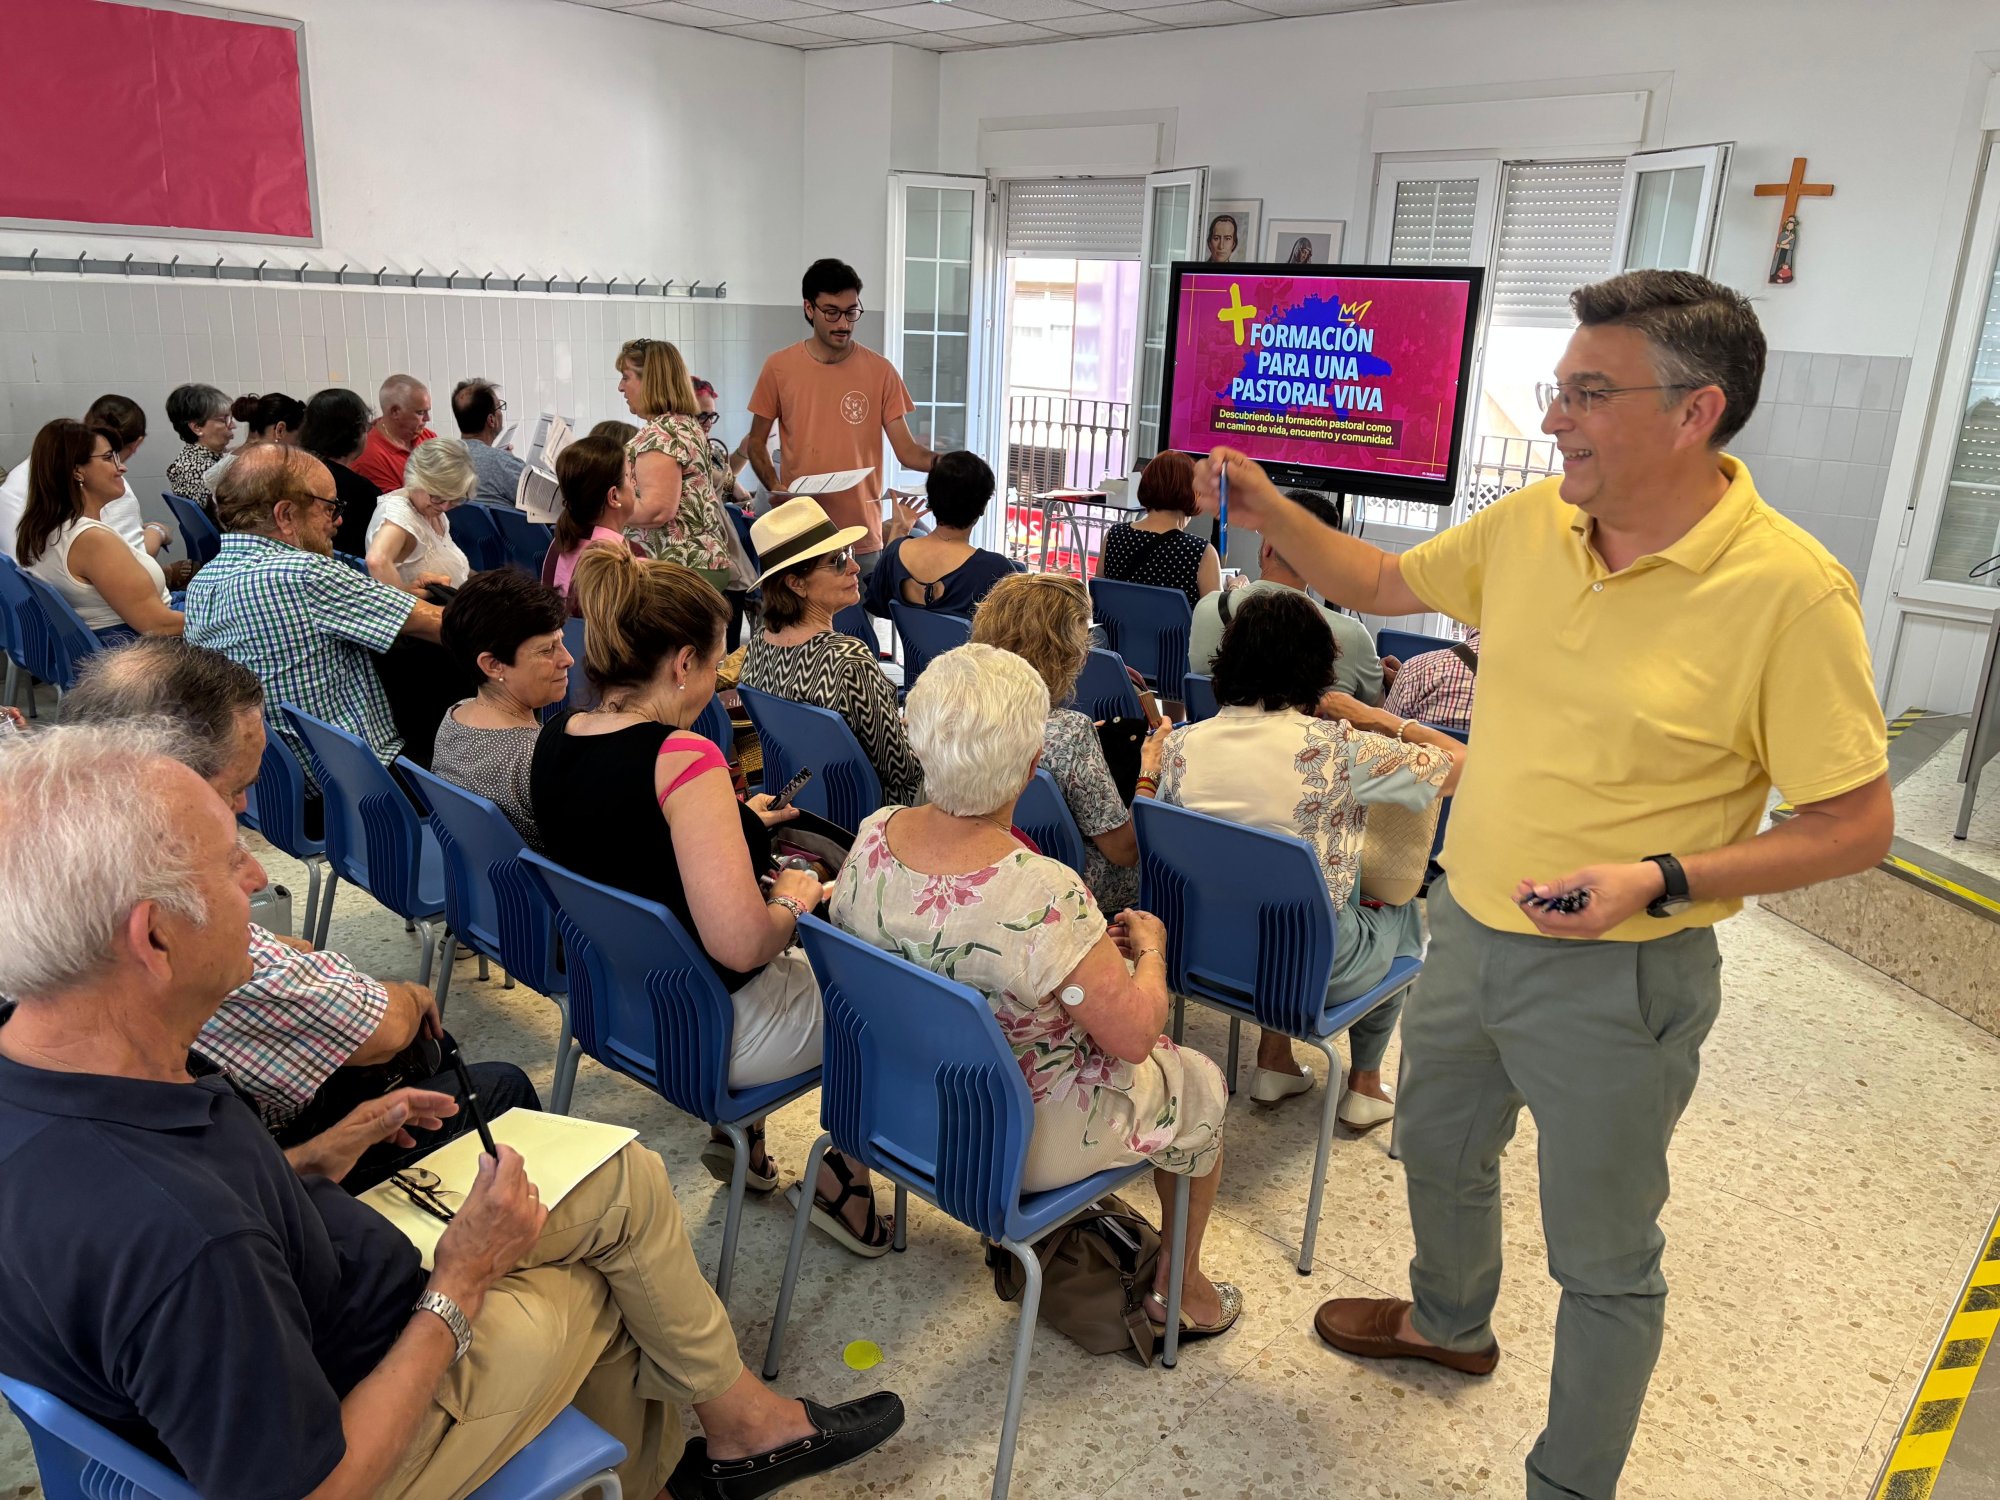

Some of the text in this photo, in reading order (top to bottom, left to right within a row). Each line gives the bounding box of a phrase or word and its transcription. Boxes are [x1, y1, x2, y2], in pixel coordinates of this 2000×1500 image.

[1250, 322, 1374, 353] FORMACIÓN
[1258, 352, 1359, 381] PARA UNA
[1231, 378, 1383, 412] PASTORAL VIVA
[1215, 421, 1394, 446] un camino de vida, encuentro y comunidad.
[1219, 409, 1392, 433] Descubriendo la formación pastoral como
